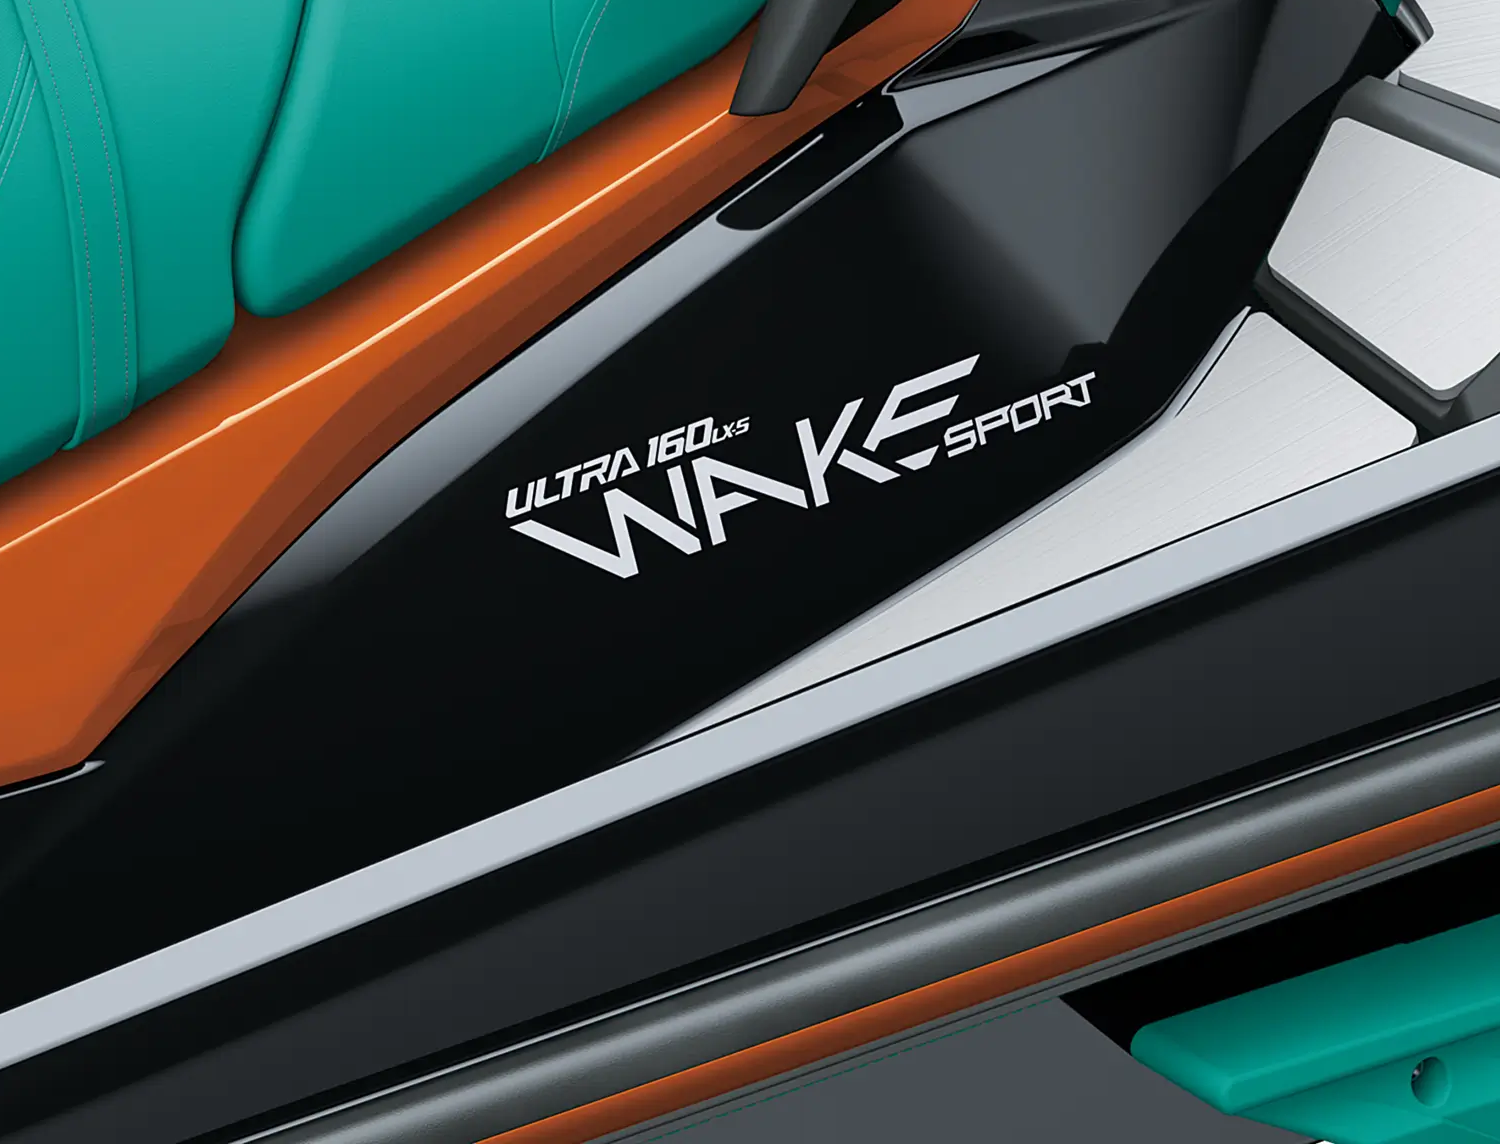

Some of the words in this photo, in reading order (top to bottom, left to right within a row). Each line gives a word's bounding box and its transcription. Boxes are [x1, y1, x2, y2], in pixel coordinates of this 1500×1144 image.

[944, 371, 1096, 458] SPORT
[505, 447, 641, 518] ULTRA
[509, 354, 980, 579] WAKE
